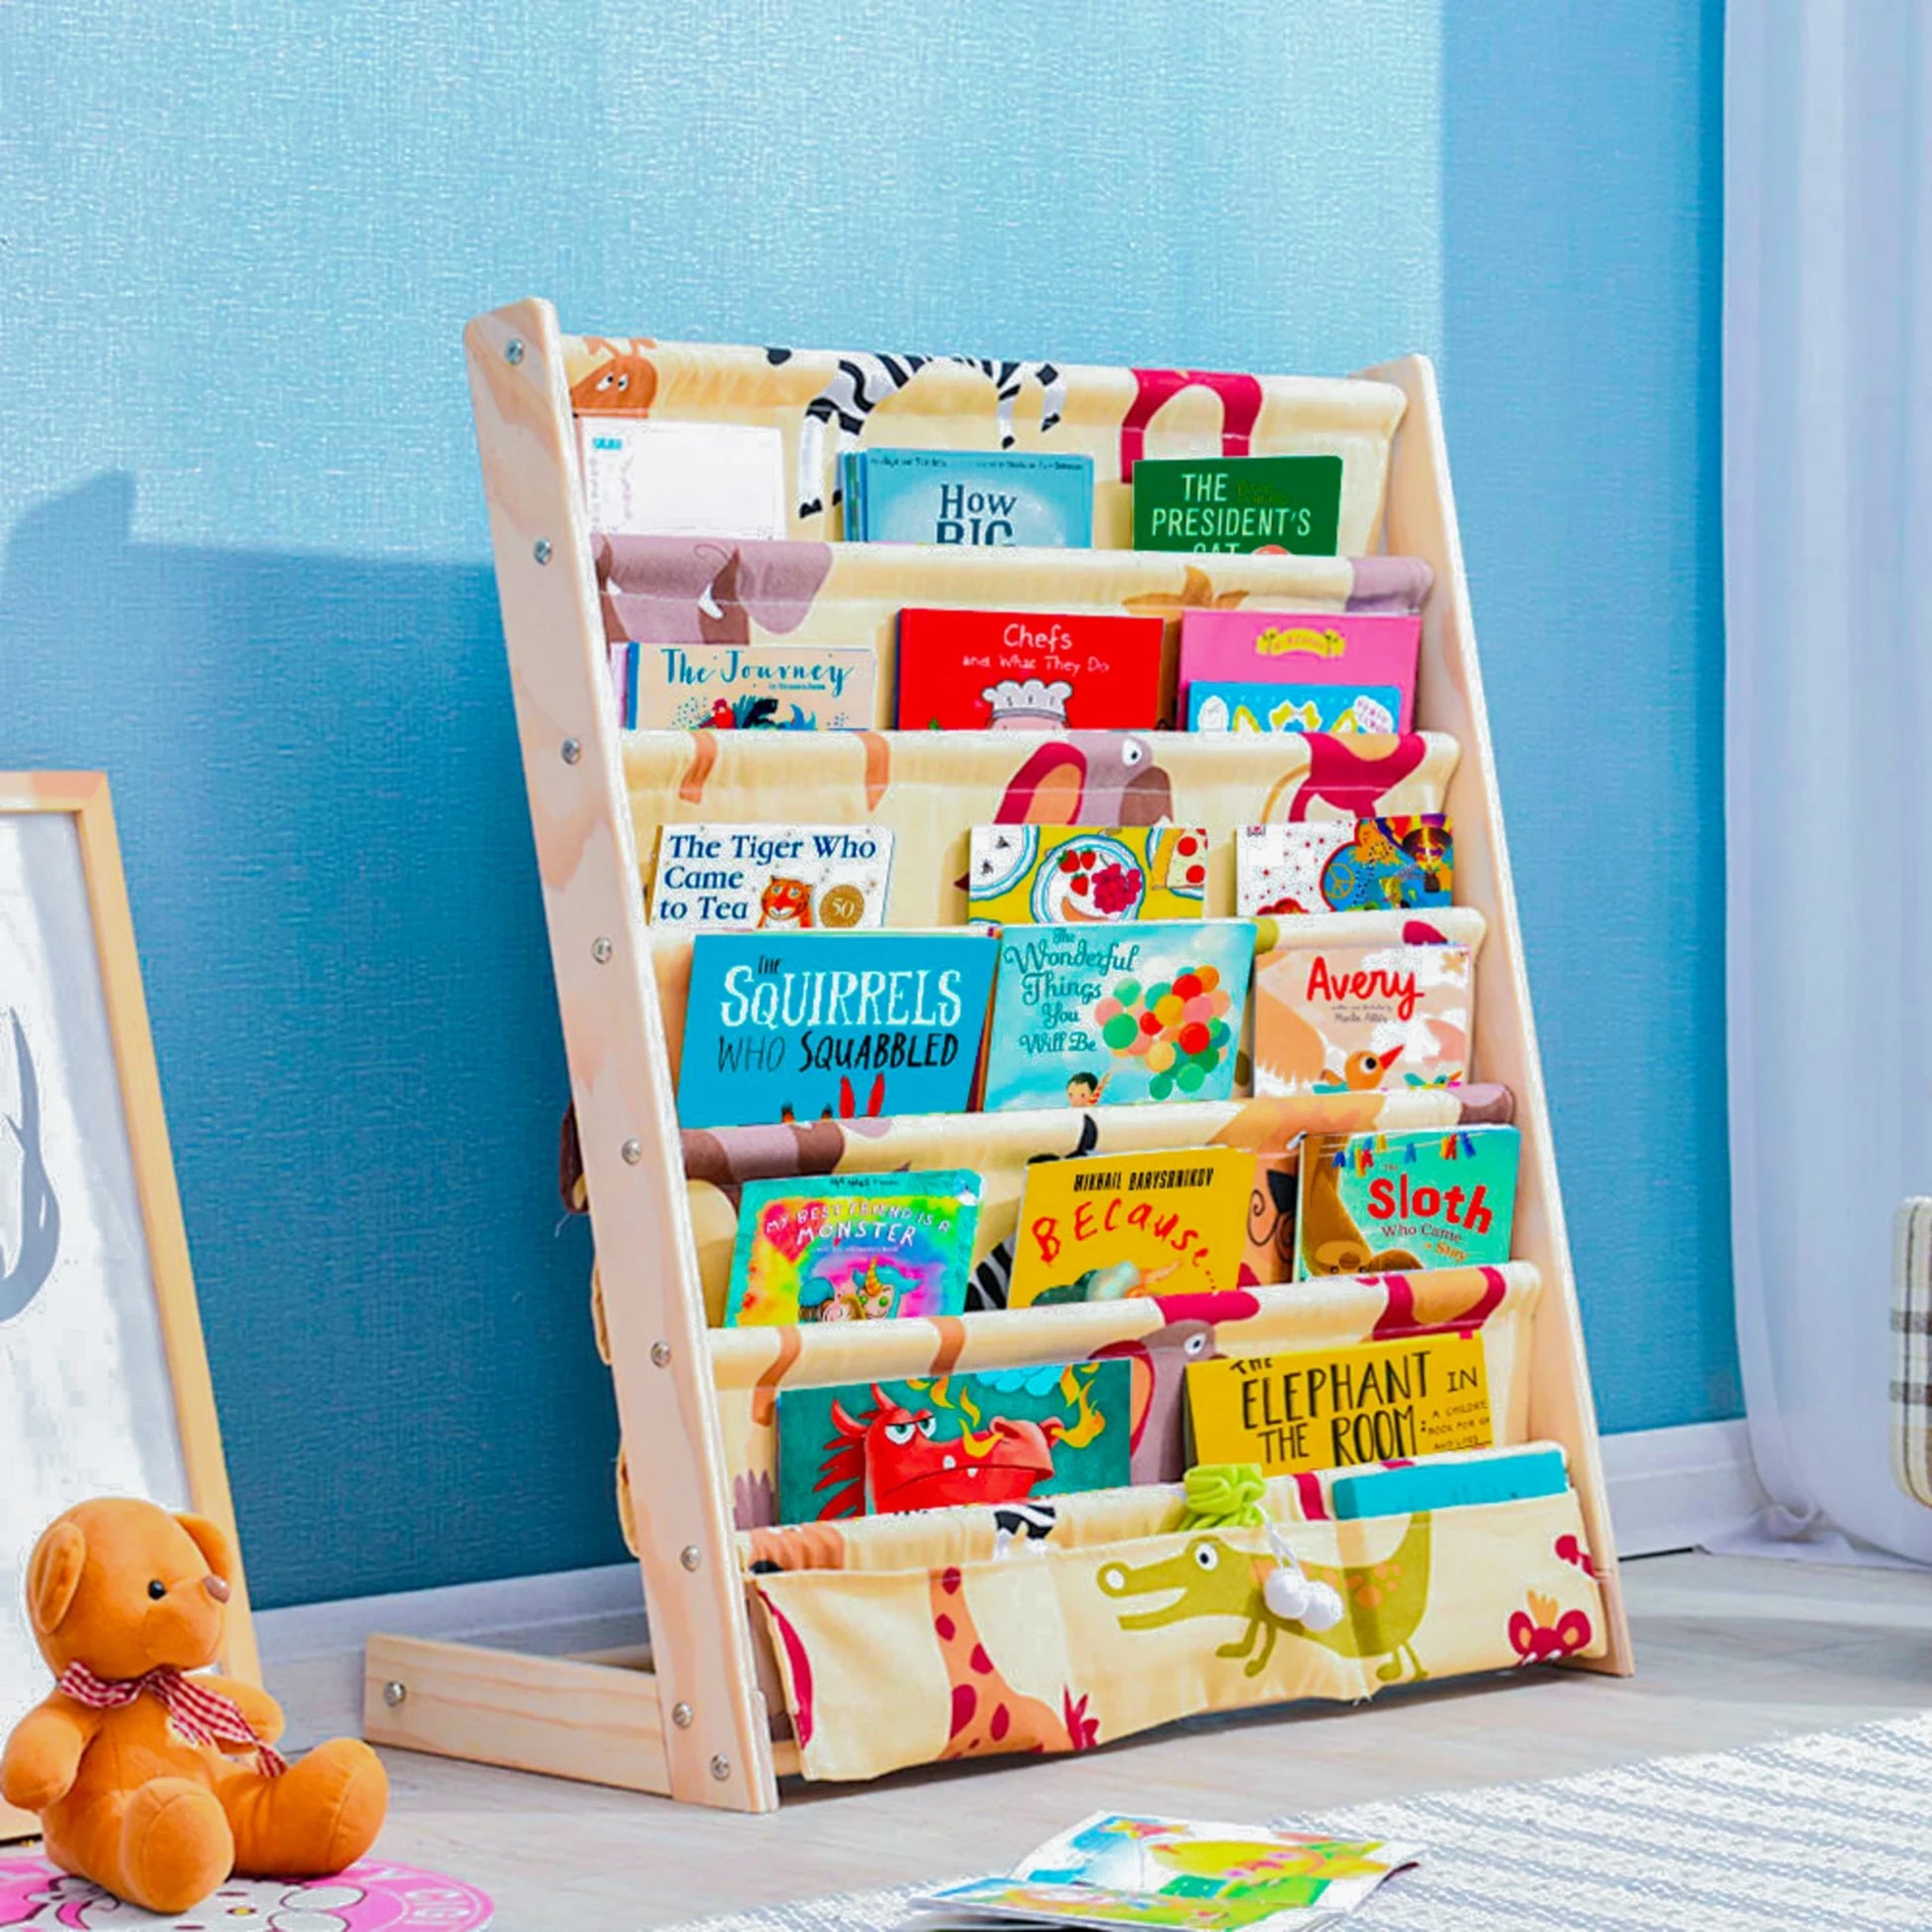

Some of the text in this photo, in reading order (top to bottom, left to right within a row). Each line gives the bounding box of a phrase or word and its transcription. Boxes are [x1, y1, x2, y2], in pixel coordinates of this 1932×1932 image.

[940, 483, 1017, 518] How
[1181, 474, 1228, 501] THE
[1152, 507, 1311, 536] PRESIDENT'S
[1004, 623, 1072, 653] Chefs
[660, 648, 854, 698] The Journey
[963, 656, 991, 668] and
[1043, 655, 1081, 677] They
[1087, 656, 1110, 673] Do
[669, 834, 877, 866] The Tiger Who
[664, 866, 744, 890] Came
[659, 896, 748, 920] to Tea
[1052, 927, 1075, 945] The
[1003, 938, 1141, 976] Wonderful
[721, 964, 962, 1031] SQUIRRELS
[1022, 970, 1102, 1006] Things
[1307, 956, 1425, 1022] Avery
[1041, 1002, 1080, 1030] You
[717, 1030, 959, 1073] WHO SQUABBLED
[1019, 1031, 1097, 1054] Will Be
[797, 1204, 843, 1225] BEST
[1367, 1173, 1493, 1235] Sloth
[796, 1219, 916, 1247] MONSTER
[1381, 1222, 1462, 1243] Who Came
[1229, 1356, 1273, 1375] THE
[1242, 1350, 1478, 1430] ELEPHANT IN
[1257, 1422, 1310, 1464] THE
